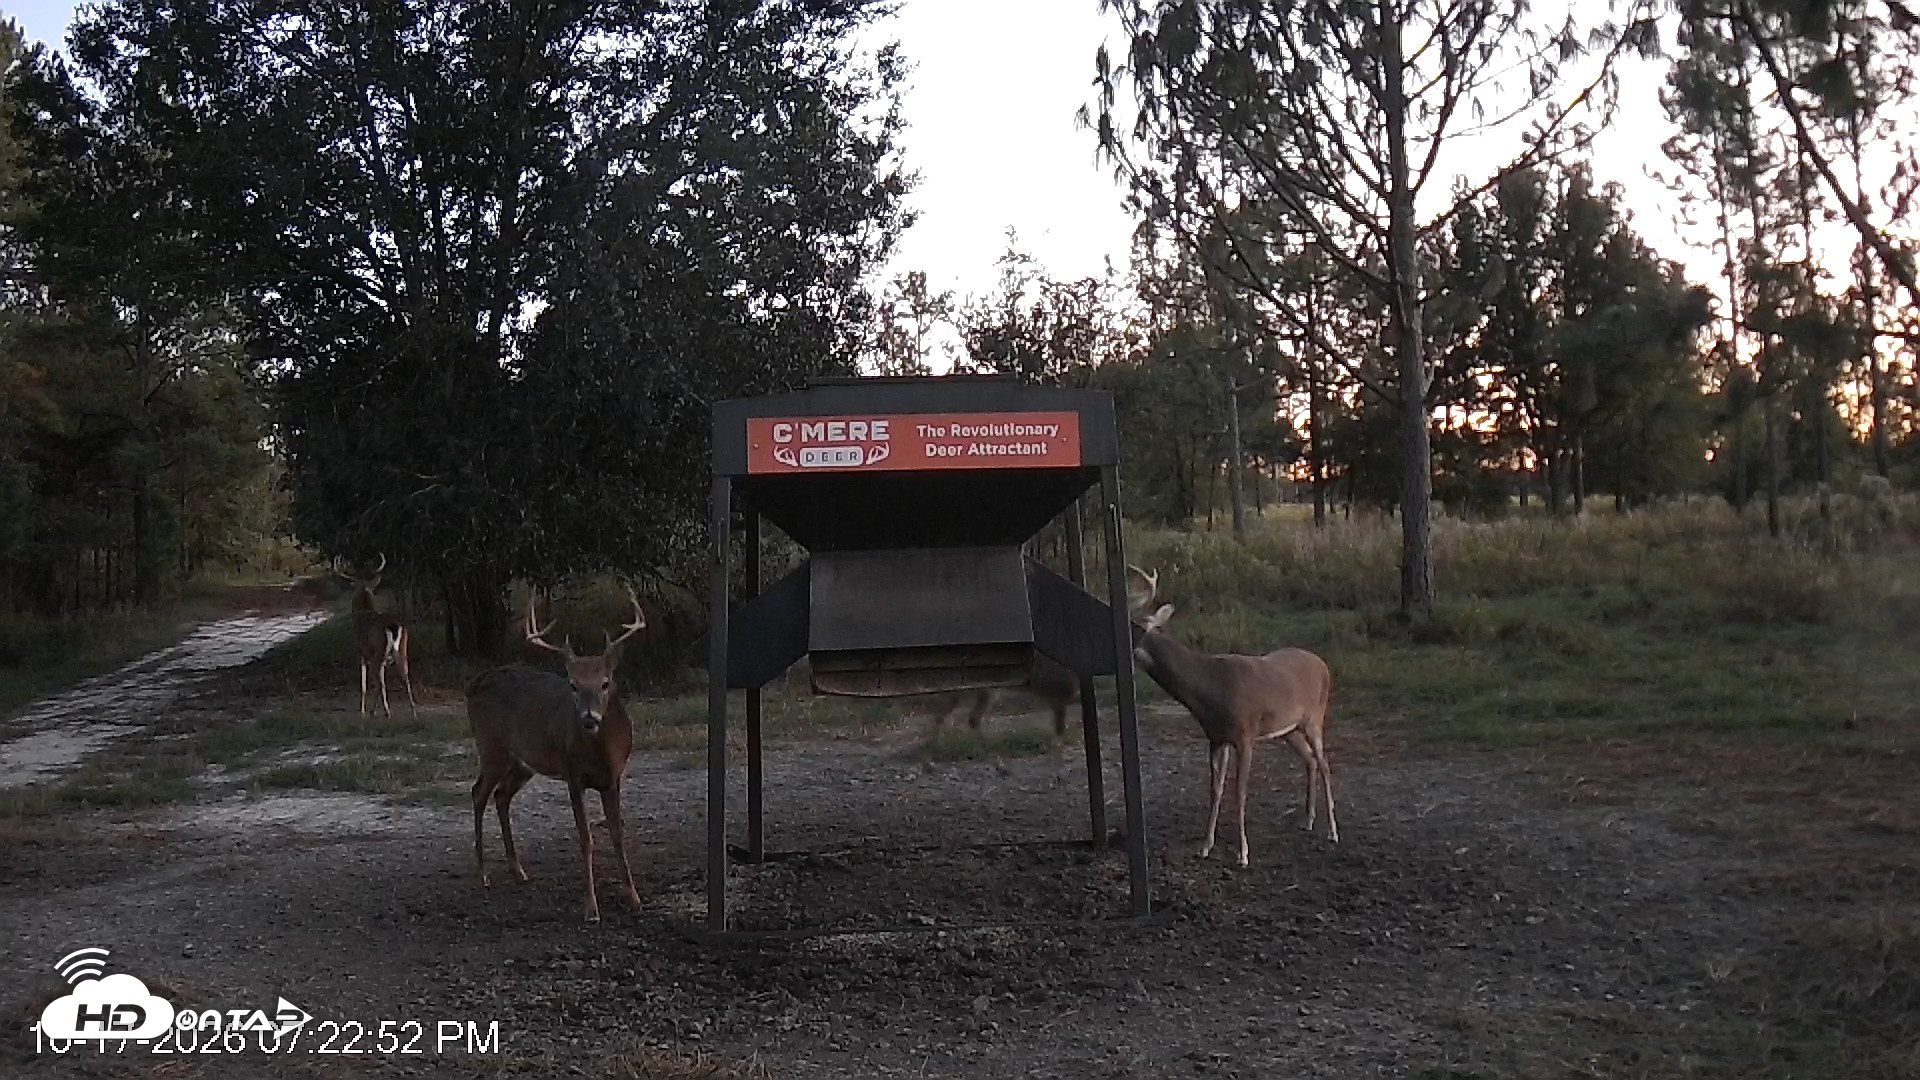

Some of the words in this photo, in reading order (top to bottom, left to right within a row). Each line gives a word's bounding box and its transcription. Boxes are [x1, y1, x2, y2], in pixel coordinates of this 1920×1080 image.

[773, 420, 890, 443] C'MERE
[916, 424, 945, 438] The
[951, 422, 1059, 438] Revolutionary
[804, 450, 859, 463] DEER
[925, 443, 963, 457] Deer
[967, 442, 1048, 456] Attractant
